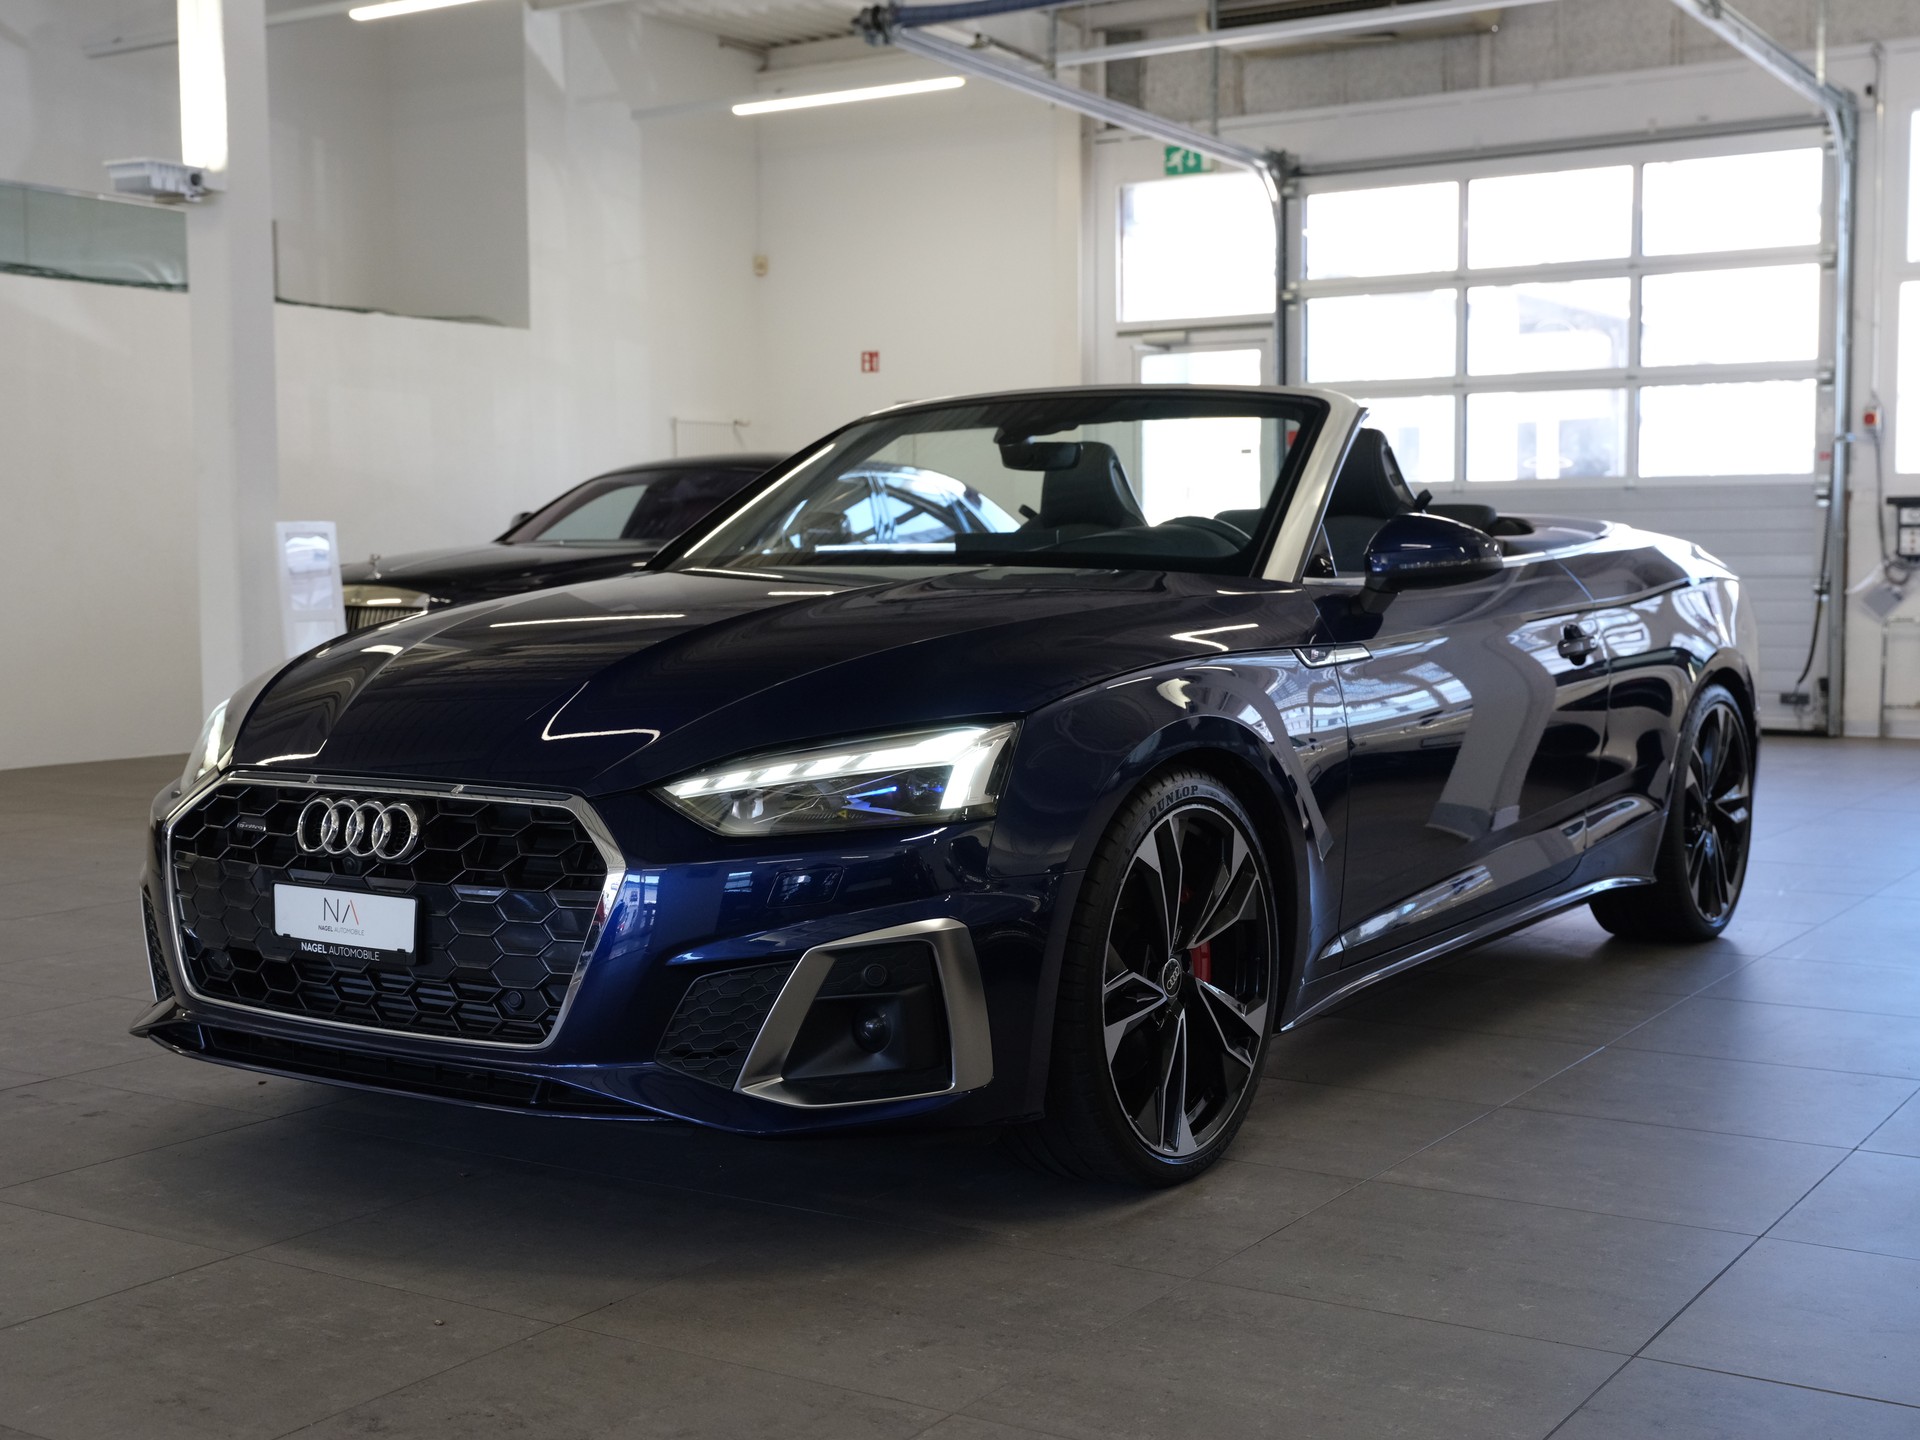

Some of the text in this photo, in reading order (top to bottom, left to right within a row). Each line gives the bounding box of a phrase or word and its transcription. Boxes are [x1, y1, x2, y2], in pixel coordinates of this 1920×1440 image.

[1148, 785, 1199, 822] DUNLOP
[334, 928, 365, 936] AUTOMOBILE
[301, 942, 380, 961] NAGEL AUTOMOBILE
